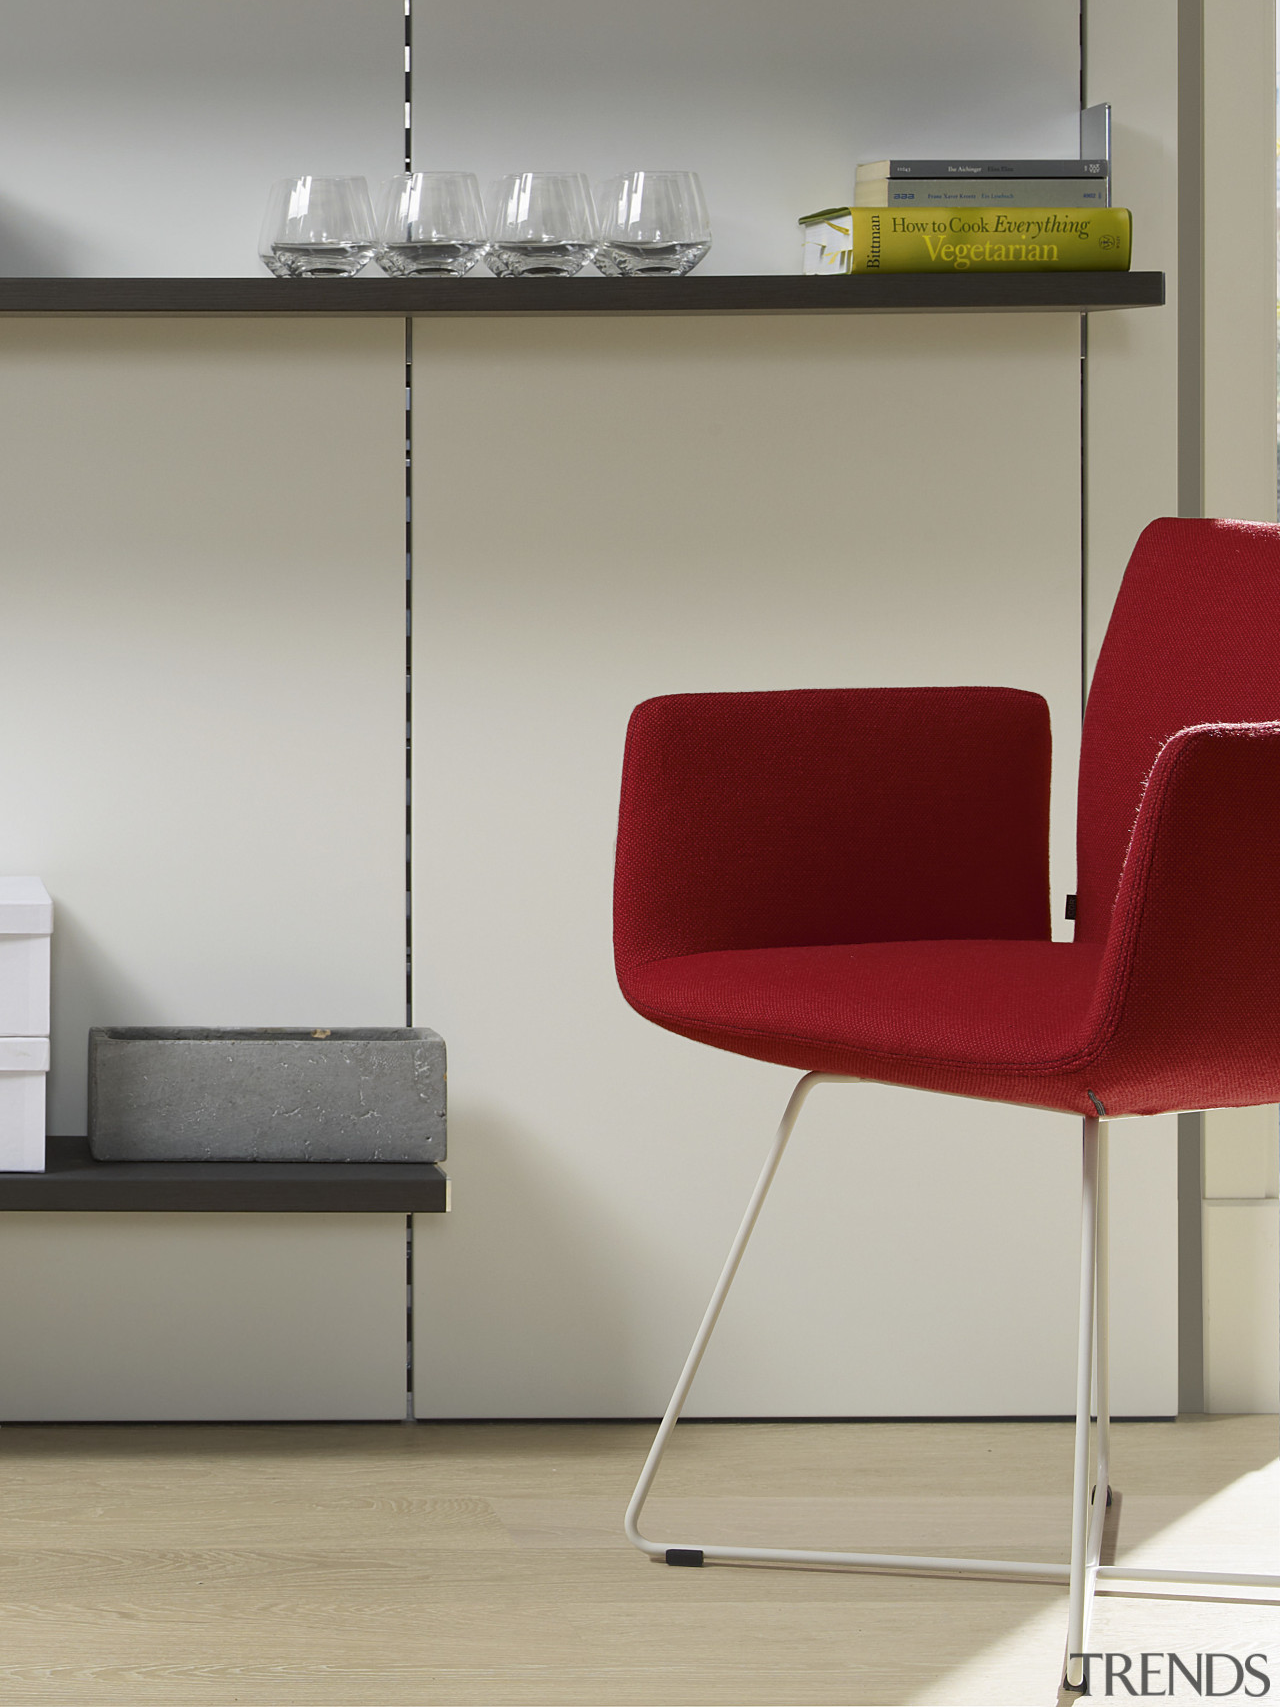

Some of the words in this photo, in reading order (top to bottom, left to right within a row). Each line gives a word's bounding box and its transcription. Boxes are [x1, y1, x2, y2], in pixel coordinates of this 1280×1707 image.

[867, 215, 881, 269] Bittman
[892, 217, 928, 233] How
[931, 221, 947, 233] to
[949, 217, 990, 233] Cook
[993, 215, 1091, 240] Everything
[922, 234, 1059, 270] Vegetarian
